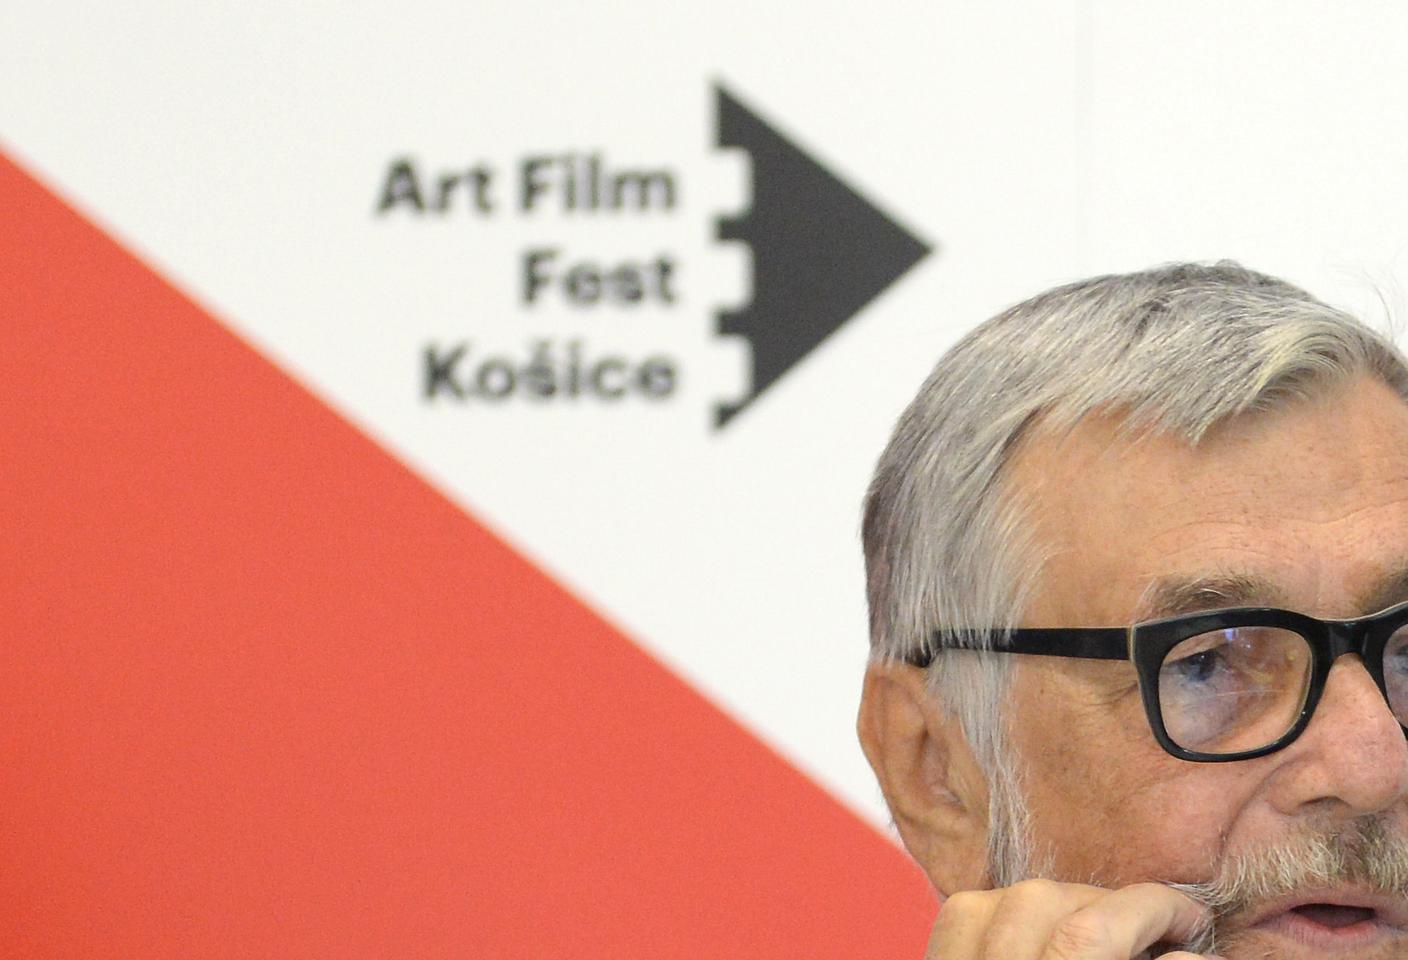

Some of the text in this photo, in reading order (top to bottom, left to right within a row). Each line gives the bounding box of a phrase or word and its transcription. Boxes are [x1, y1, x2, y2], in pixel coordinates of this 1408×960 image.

[374, 153, 678, 215] Art Film
[520, 247, 677, 306] Fest
[420, 343, 678, 402] Košice
